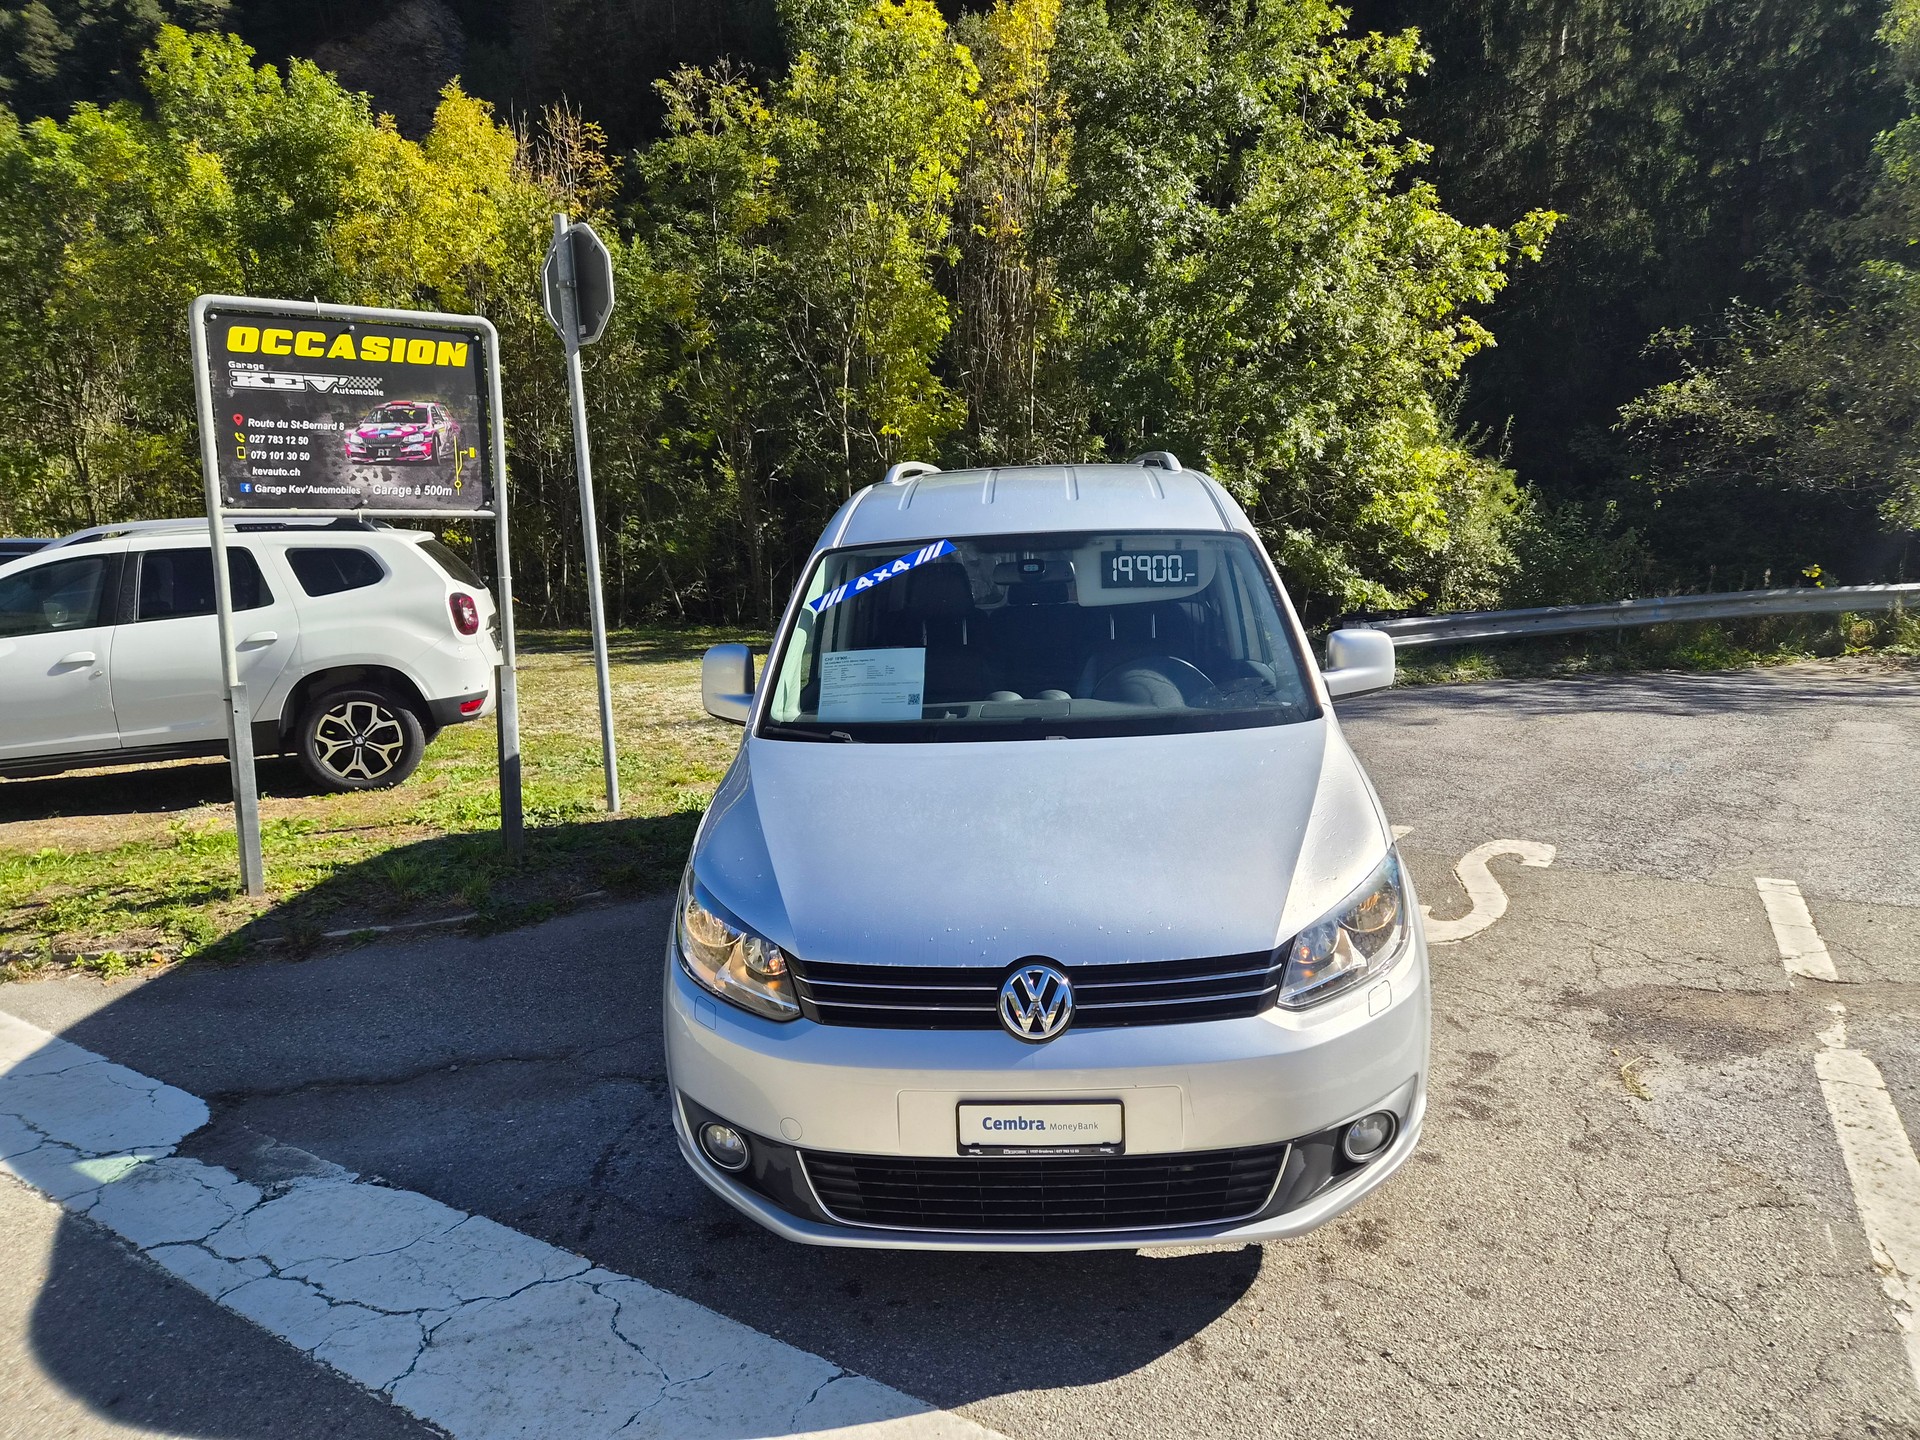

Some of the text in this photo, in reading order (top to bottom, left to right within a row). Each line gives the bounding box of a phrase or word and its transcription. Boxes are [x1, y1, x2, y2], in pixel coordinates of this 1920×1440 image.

[226, 325, 468, 368] OCCASION
[228, 360, 265, 371] Garage
[332, 386, 385, 397] Automobile
[247, 418, 345, 431] Route du St-Bernard 8
[249, 434, 309, 446] 027 783 12 50
[250, 450, 311, 461] 079 101 30 50
[252, 466, 301, 477] kevauto.ch
[254, 484, 361, 495] Garage Kev'Automobiles
[372, 484, 453, 497] Garage à 500m
[855, 559, 911, 590] 4x4
[1000, 964, 1072, 1040] VW
[982, 1116, 1099, 1133] Cembra MoneyBank
